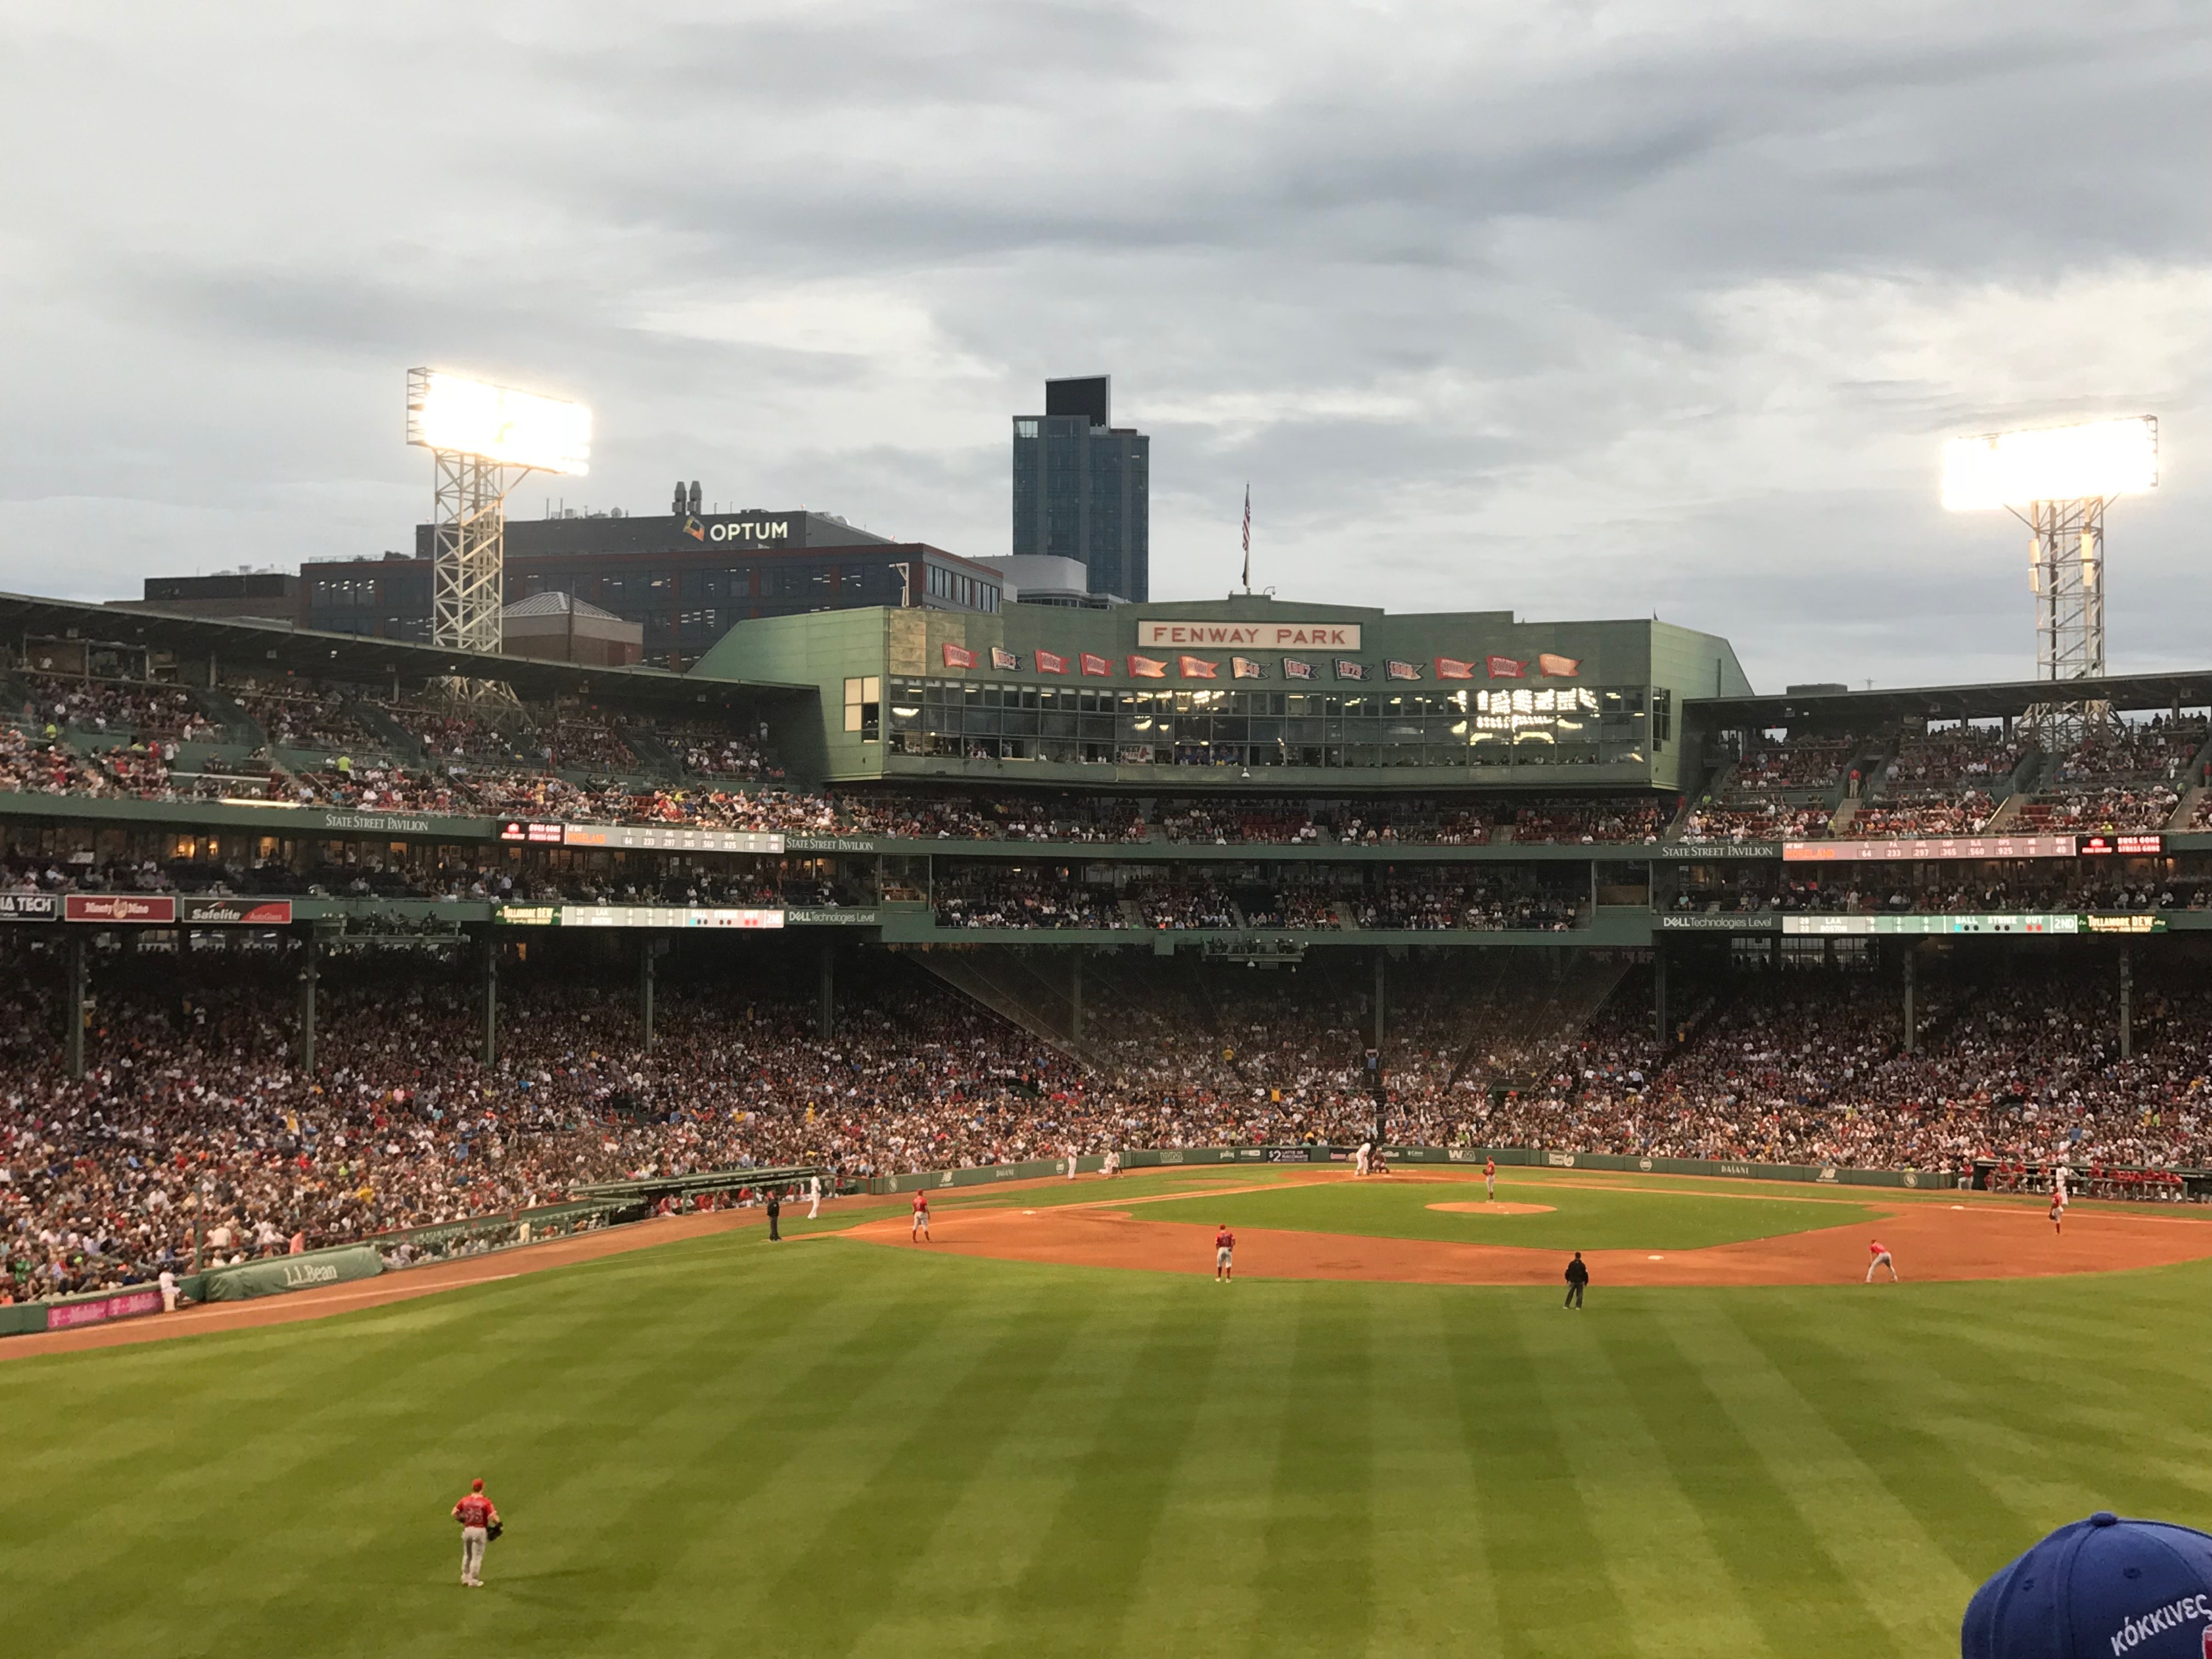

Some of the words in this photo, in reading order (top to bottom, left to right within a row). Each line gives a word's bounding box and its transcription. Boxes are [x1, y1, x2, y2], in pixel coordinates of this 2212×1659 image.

[710, 522, 788, 541] OPTUM
[1154, 627, 1260, 644] FENWAY
[1277, 628, 1346, 645] PARK
[1288, 662, 1311, 675] 1967
[1492, 660, 1519, 673] 2007
[326, 814, 352, 827] STATE
[353, 816, 385, 829] STREET
[387, 817, 428, 831] PAVILION
[567, 833, 606, 844] MORELAND
[786, 838, 809, 848] STATE
[810, 838, 837, 849] STREET
[838, 839, 873, 850] PAVILION
[723, 841, 737, 849] .925
[1662, 847, 1690, 856] STATE
[1691, 846, 1725, 856] STREET
[1728, 845, 1773, 856] PAVILION
[1785, 849, 1835, 860] MORELAND
[17, 896, 52, 912] TECH
[192, 908, 241, 920] Safelite
[249, 912, 283, 921] AutoGlass
[691, 910, 708, 918] BALL
[766, 913, 782, 924] 2ND
[857, 912, 875, 922] Level
[1748, 917, 1772, 927] Level
[1955, 916, 1978, 924] BALL
[2024, 916, 2043, 924] OUT
[2054, 918, 2074, 929] 2ND
[2087, 915, 2130, 927] TULLAMORE
[2131, 916, 2154, 927] DEW
[1268, 1150, 1282, 1162] $2
